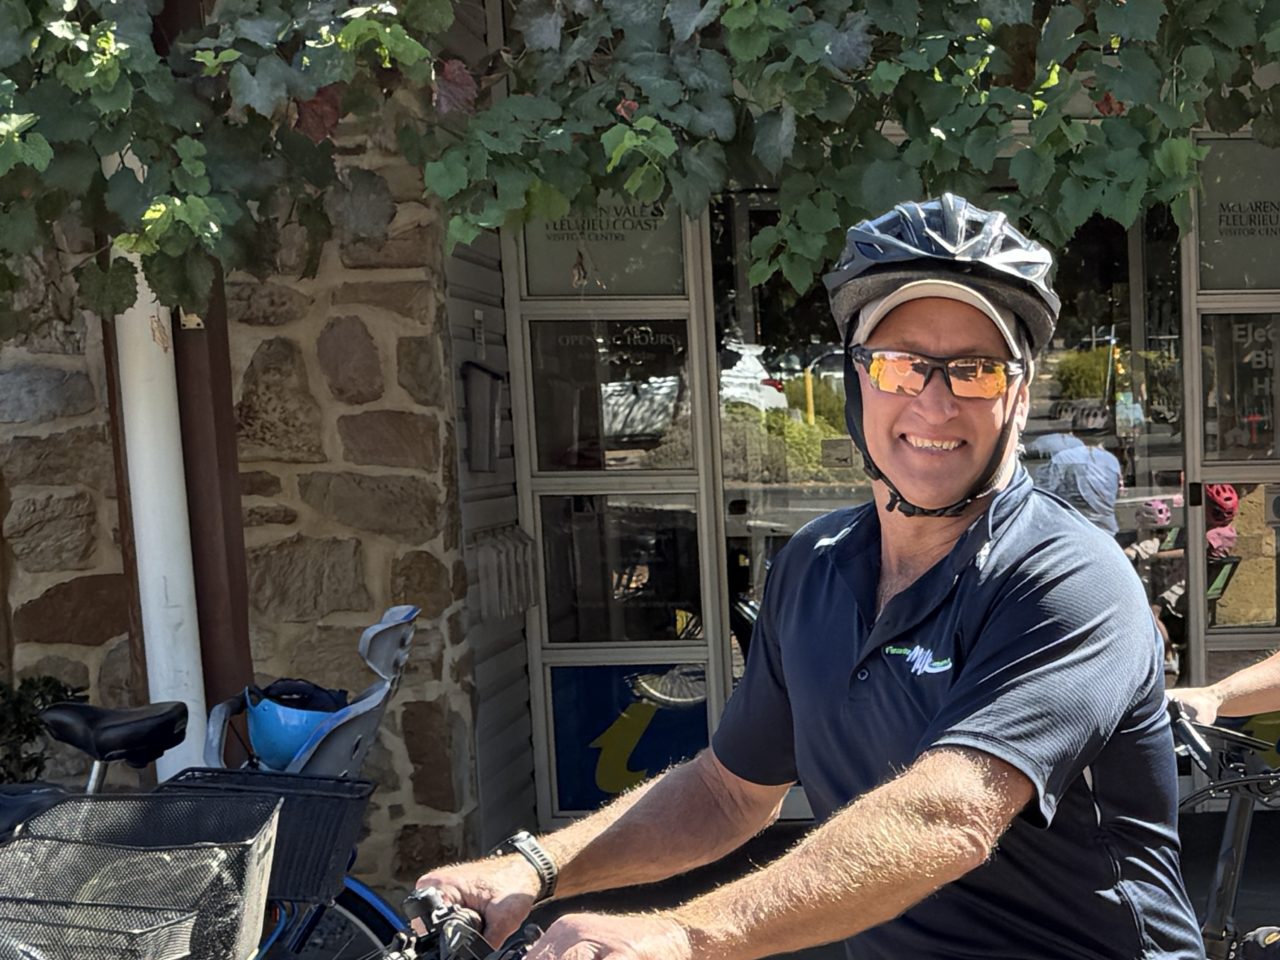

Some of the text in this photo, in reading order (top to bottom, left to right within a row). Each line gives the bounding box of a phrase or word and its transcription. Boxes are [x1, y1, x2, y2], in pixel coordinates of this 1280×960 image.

[613, 219, 658, 231] COAST
[1219, 214, 1279, 226] FLEURIEU
[1219, 228, 1256, 236] VISITOR
